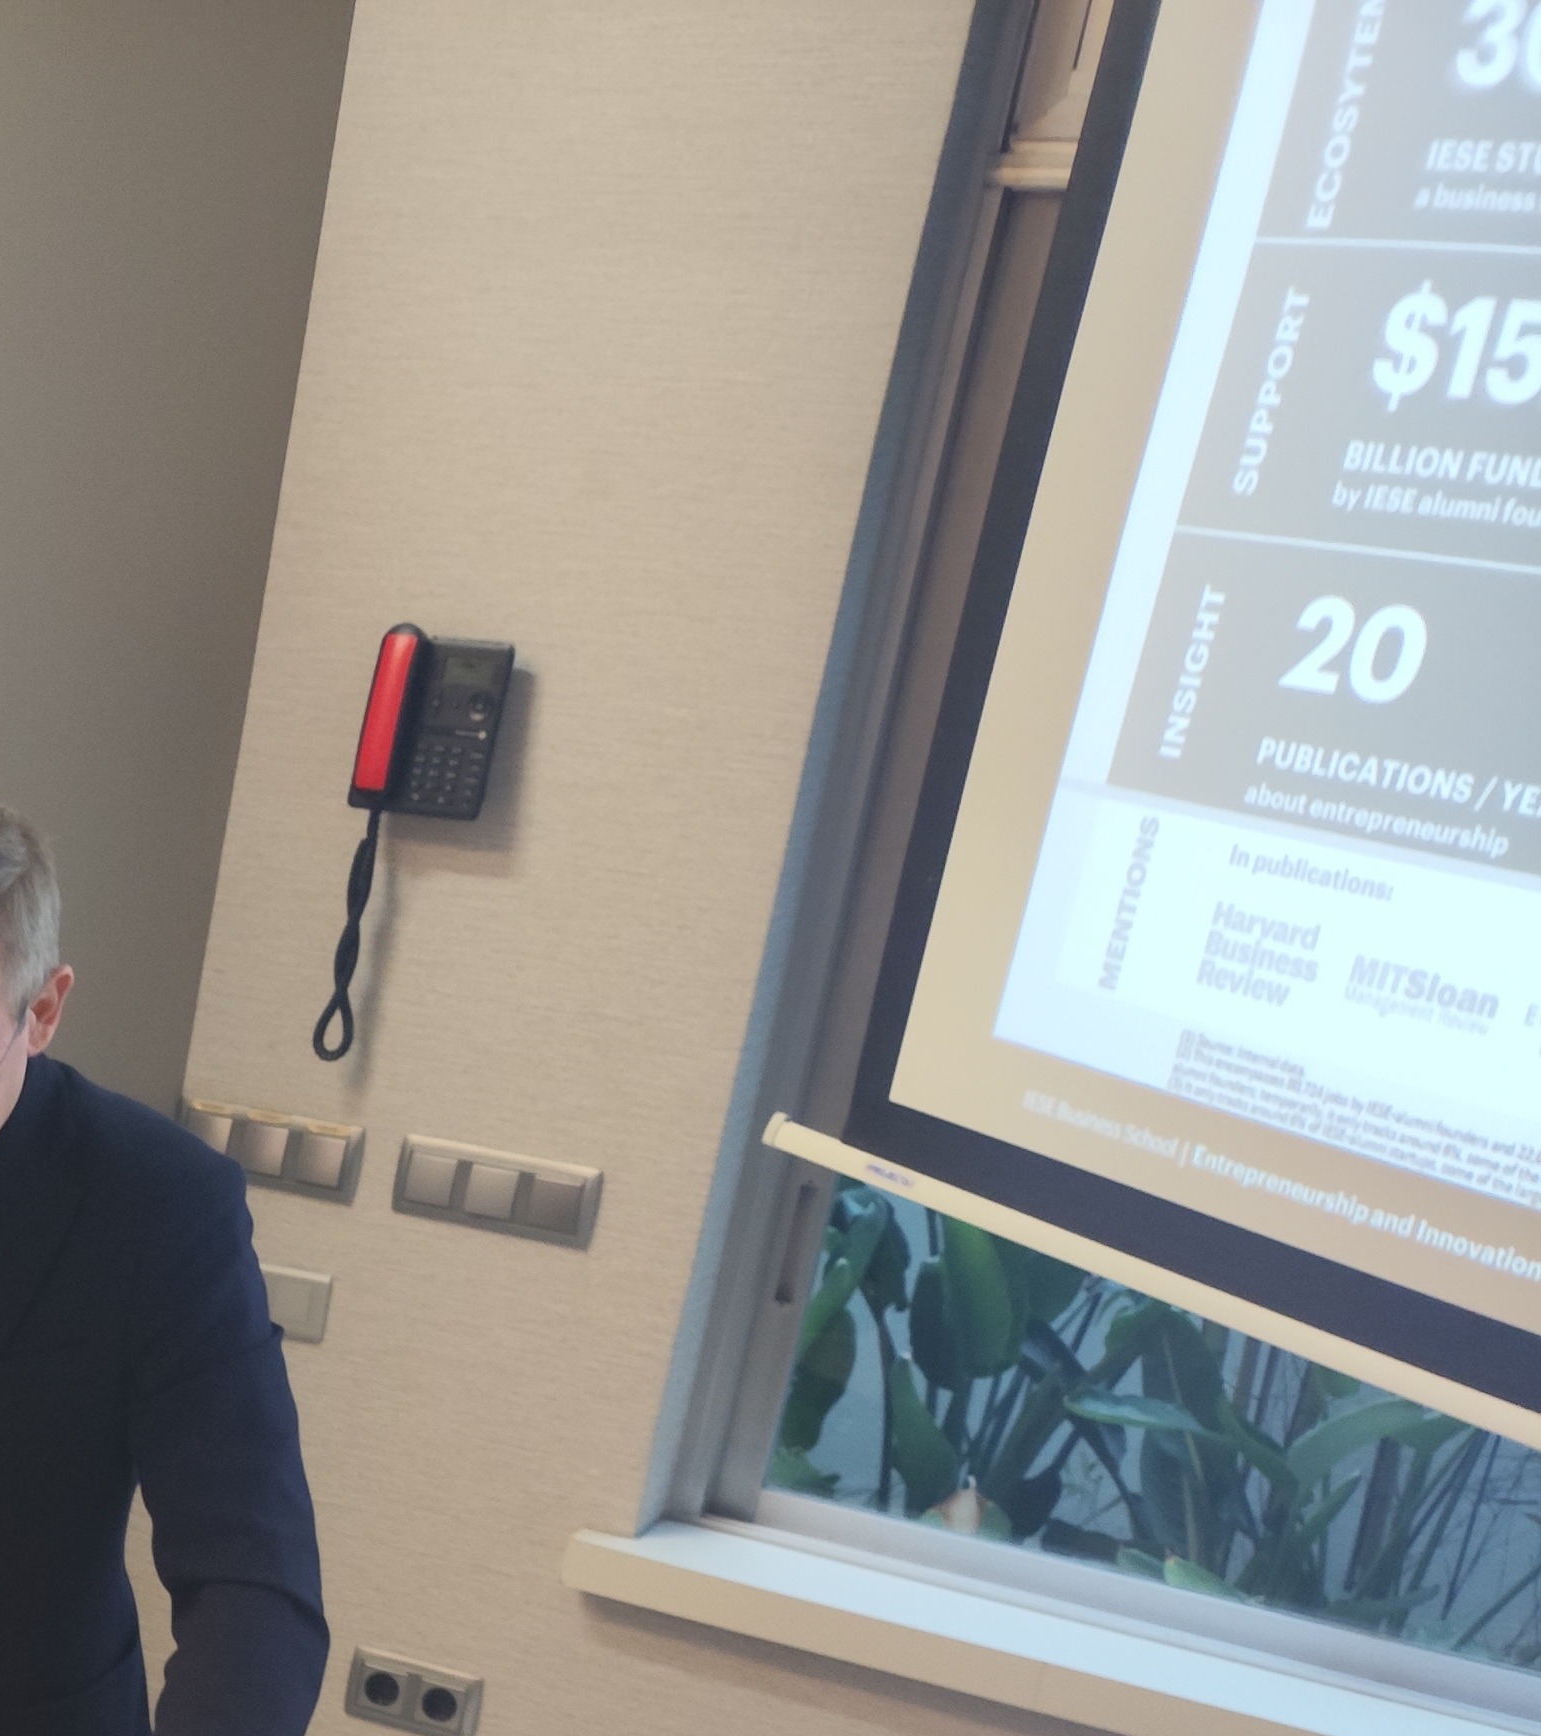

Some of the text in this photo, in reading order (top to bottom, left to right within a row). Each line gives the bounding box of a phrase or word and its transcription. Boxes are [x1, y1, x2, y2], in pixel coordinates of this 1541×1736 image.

[1425, 138, 1493, 173] IESE
[1432, 181, 1537, 213] business
[1232, 285, 1312, 497] SUPPORT
[1343, 438, 1465, 480] BILLION
[1331, 479, 1362, 512] by
[1363, 483, 1419, 514] IESE
[1417, 489, 1502, 523] alumni
[1158, 583, 1228, 760] INSIGHT
[1278, 592, 1429, 707] 20
[1256, 735, 1475, 804] PUBLICATIONS
[1473, 775, 1499, 812] /
[1244, 782, 1510, 859] about entrepreneurship
[1228, 844, 1394, 902] In publications:
[1098, 814, 1161, 991] MENTIONS
[1212, 901, 1321, 951] Harvard
[1196, 958, 1291, 1007] Review
[1204, 928, 1319, 983] Business
[1191, 1143, 1373, 1227] Entrepreneurship
[1370, 1203, 1418, 1240] and
[1416, 1218, 1541, 1282] Innovation
